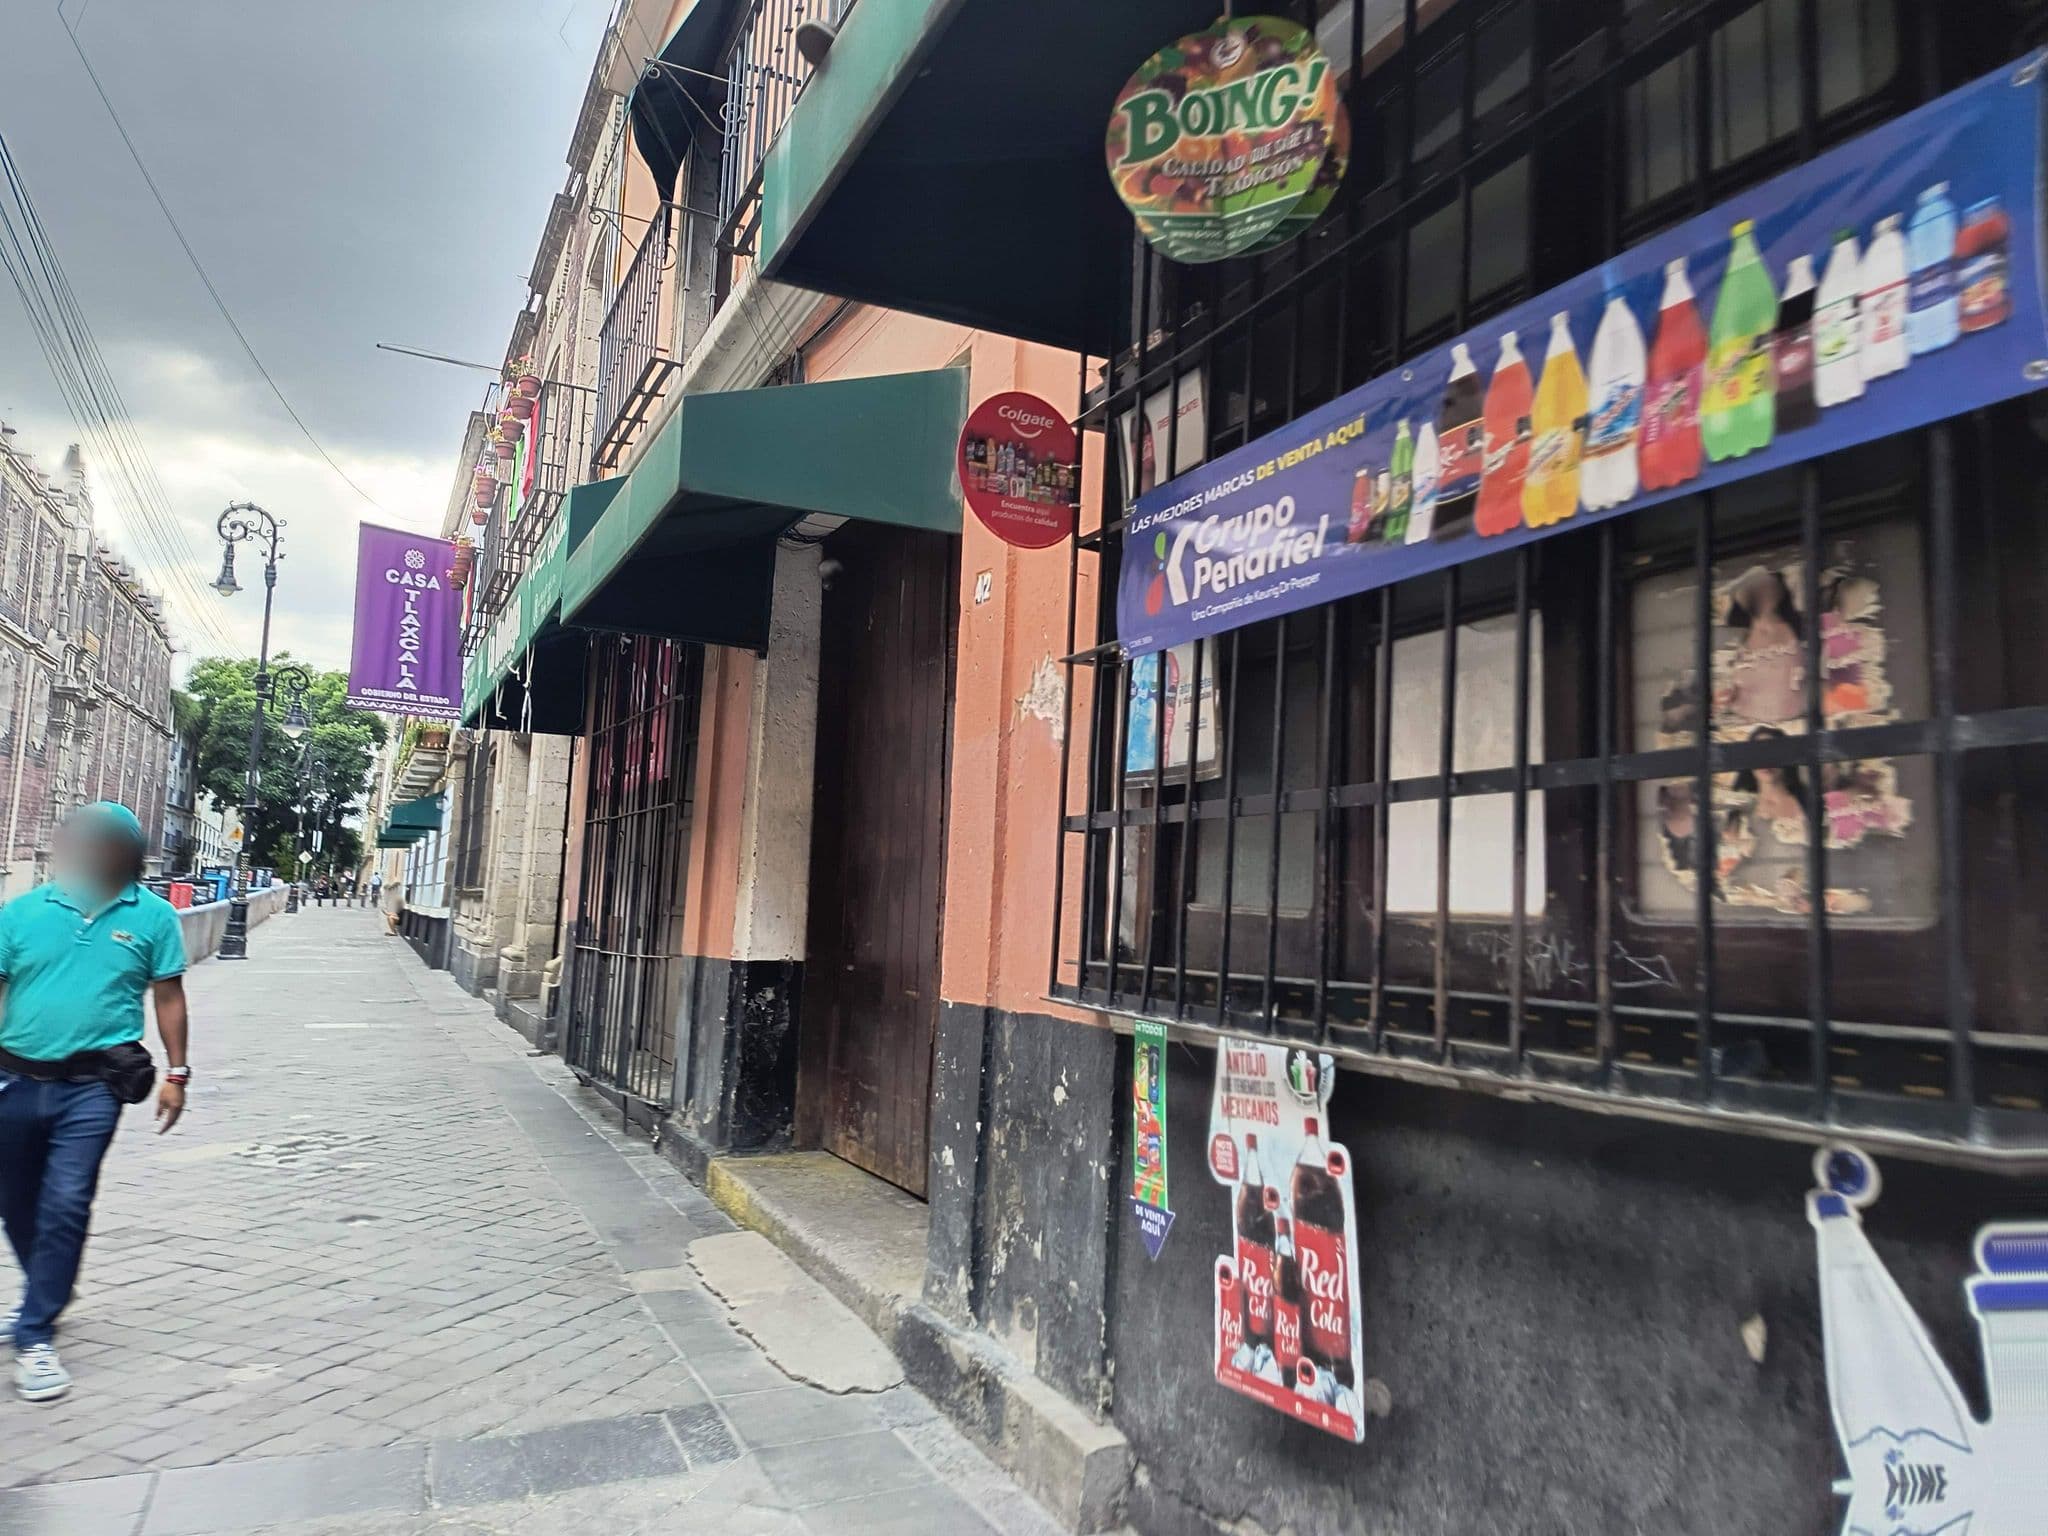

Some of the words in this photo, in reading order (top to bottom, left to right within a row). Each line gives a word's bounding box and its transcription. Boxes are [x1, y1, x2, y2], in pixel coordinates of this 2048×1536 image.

[1119, 60, 1328, 166] BOING!
[1162, 157, 1245, 178] CALIDAD
[998, 405, 1055, 429] Colgate
[1131, 515, 1151, 534] LAS
[1151, 493, 1203, 525] MEJORES
[1204, 470, 1255, 504] MARCAS
[1256, 460, 1275, 481] DE
[1276, 438, 1323, 471] VENTA
[1324, 412, 1366, 450] AQUÍ
[1001, 500, 1035, 513] Encuentra
[1193, 495, 1296, 554] Grupo
[1191, 514, 1329, 601] Peñafiel
[385, 568, 440, 591] CASA
[1192, 610, 1206, 622] Una
[396, 588, 421, 691] TLAXCALA
[402, 692, 419, 702] DEL
[1226, 1051, 1267, 1078] ANTOJO
[1220, 1095, 1280, 1127] MEXICANOS
[1135, 1204, 1144, 1217] DE
[1144, 1207, 1166, 1227] VENTA
[1300, 1246, 1344, 1303] Red
[1221, 1309, 1242, 1337] Red
[1276, 1309, 1300, 1340] Red
[1310, 1300, 1343, 1335] Cola
